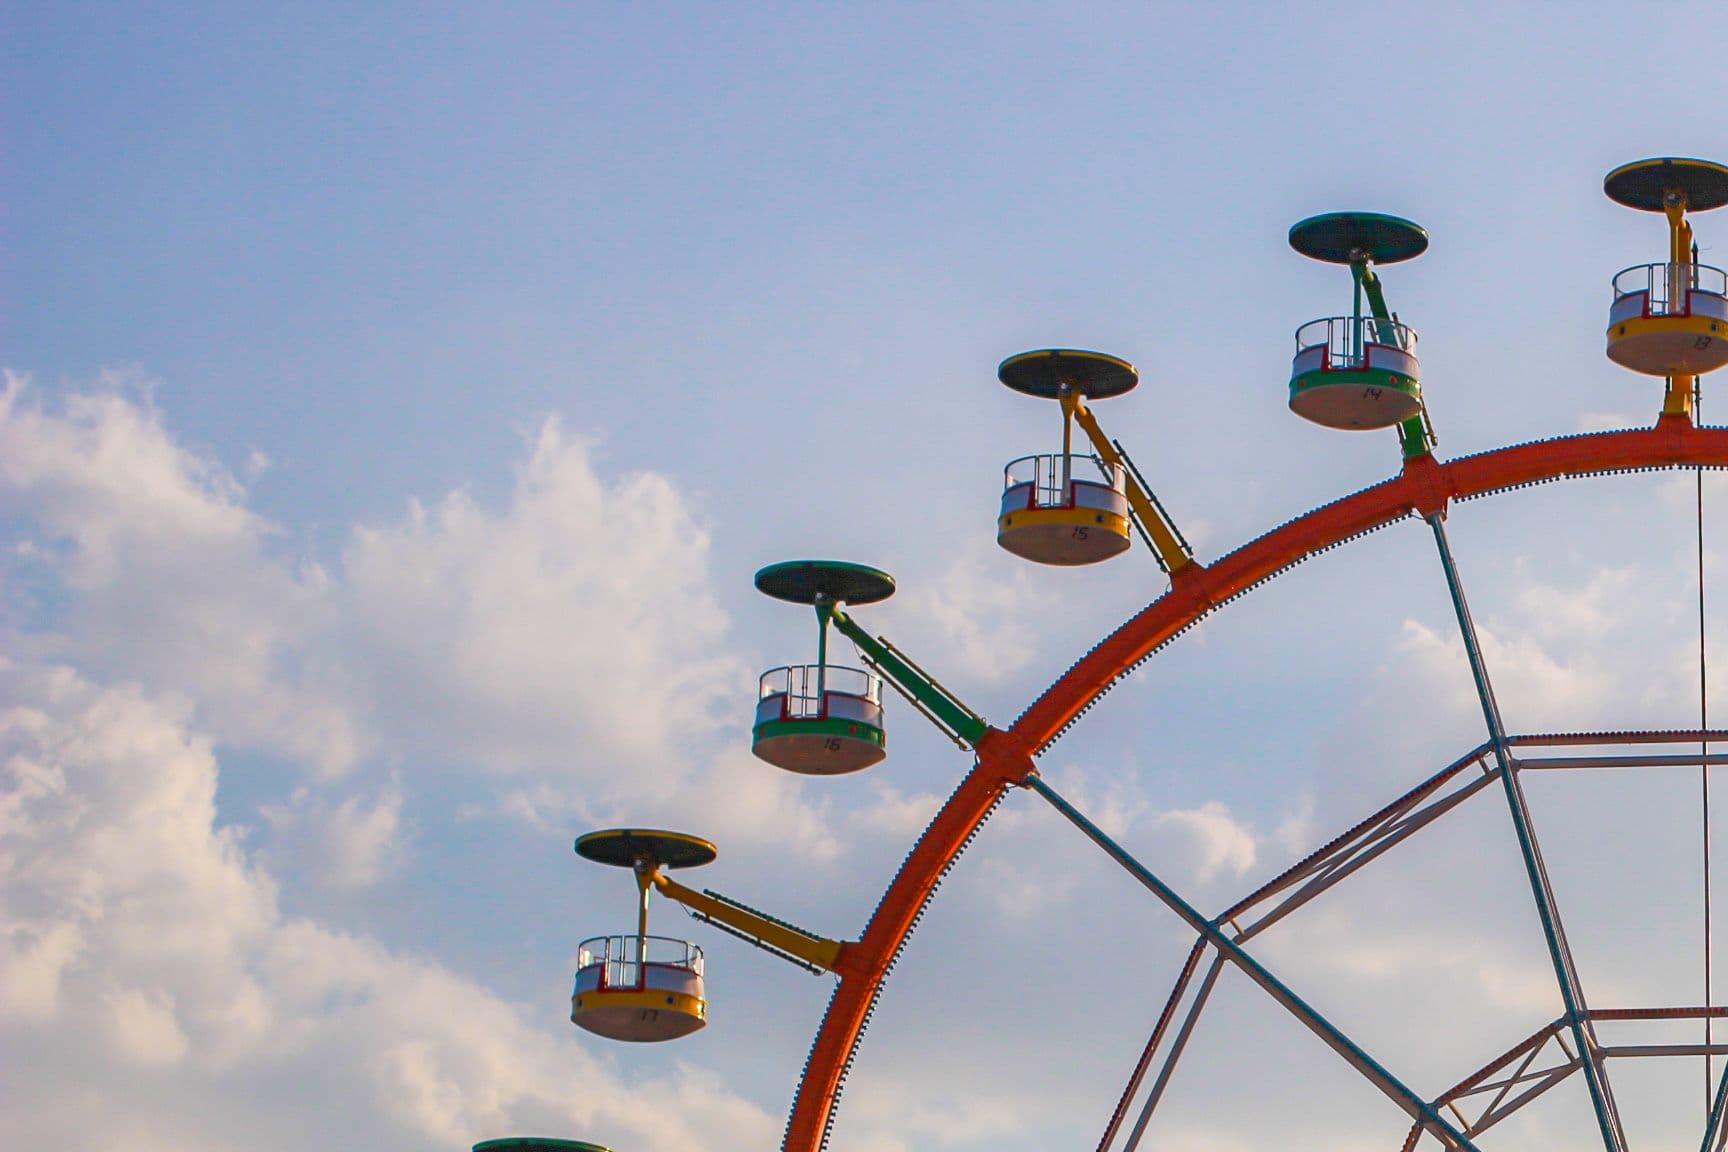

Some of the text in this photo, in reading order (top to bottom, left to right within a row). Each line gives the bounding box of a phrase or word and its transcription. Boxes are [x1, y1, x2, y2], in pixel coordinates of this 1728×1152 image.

[1363, 387, 1383, 400] 14
[1072, 526, 1088, 540] 15
[823, 738, 840, 751] 16
[642, 1008, 658, 1021] 17
